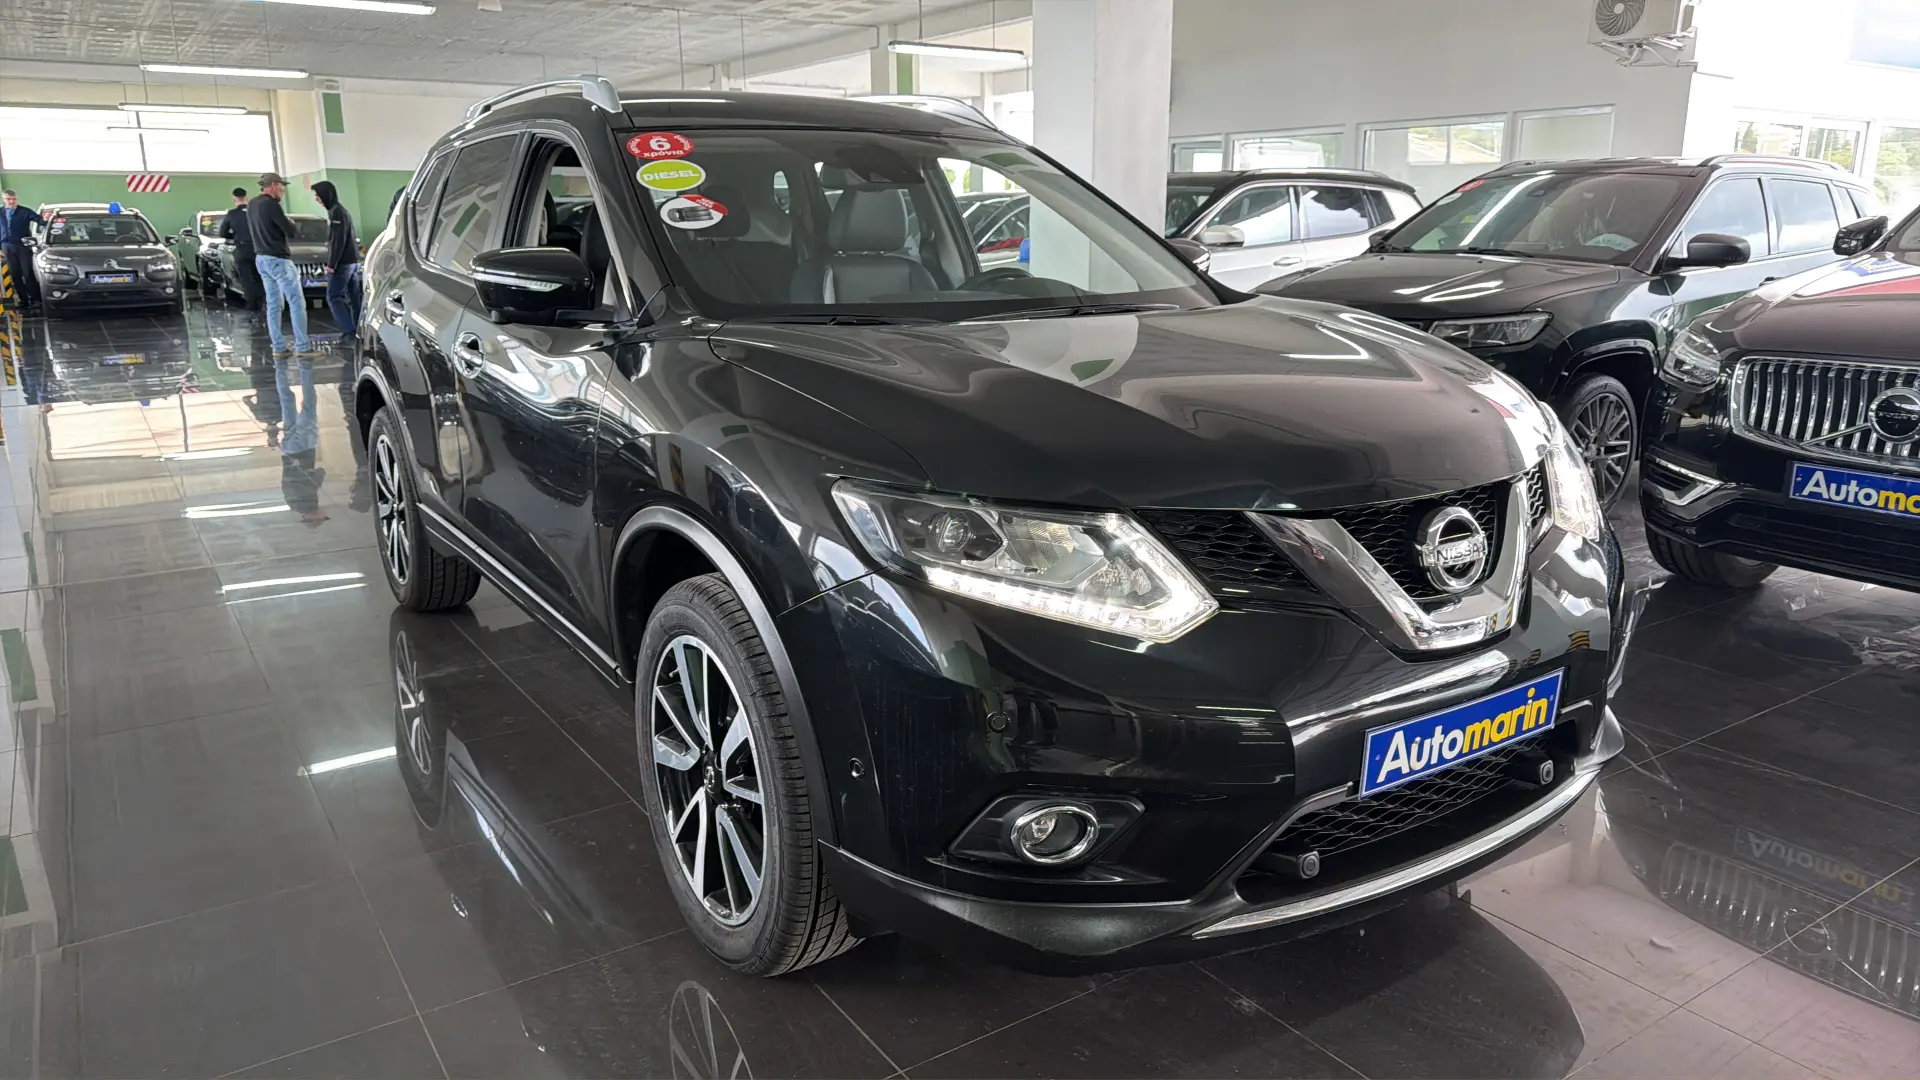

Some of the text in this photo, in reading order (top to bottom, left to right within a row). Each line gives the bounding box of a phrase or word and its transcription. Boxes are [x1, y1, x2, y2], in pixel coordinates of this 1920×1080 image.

[649, 137, 671, 151] 6
[643, 150, 684, 158] χρόνια
[642, 169, 699, 181] DIESEL
[1375, 687, 1548, 784] Automarin
